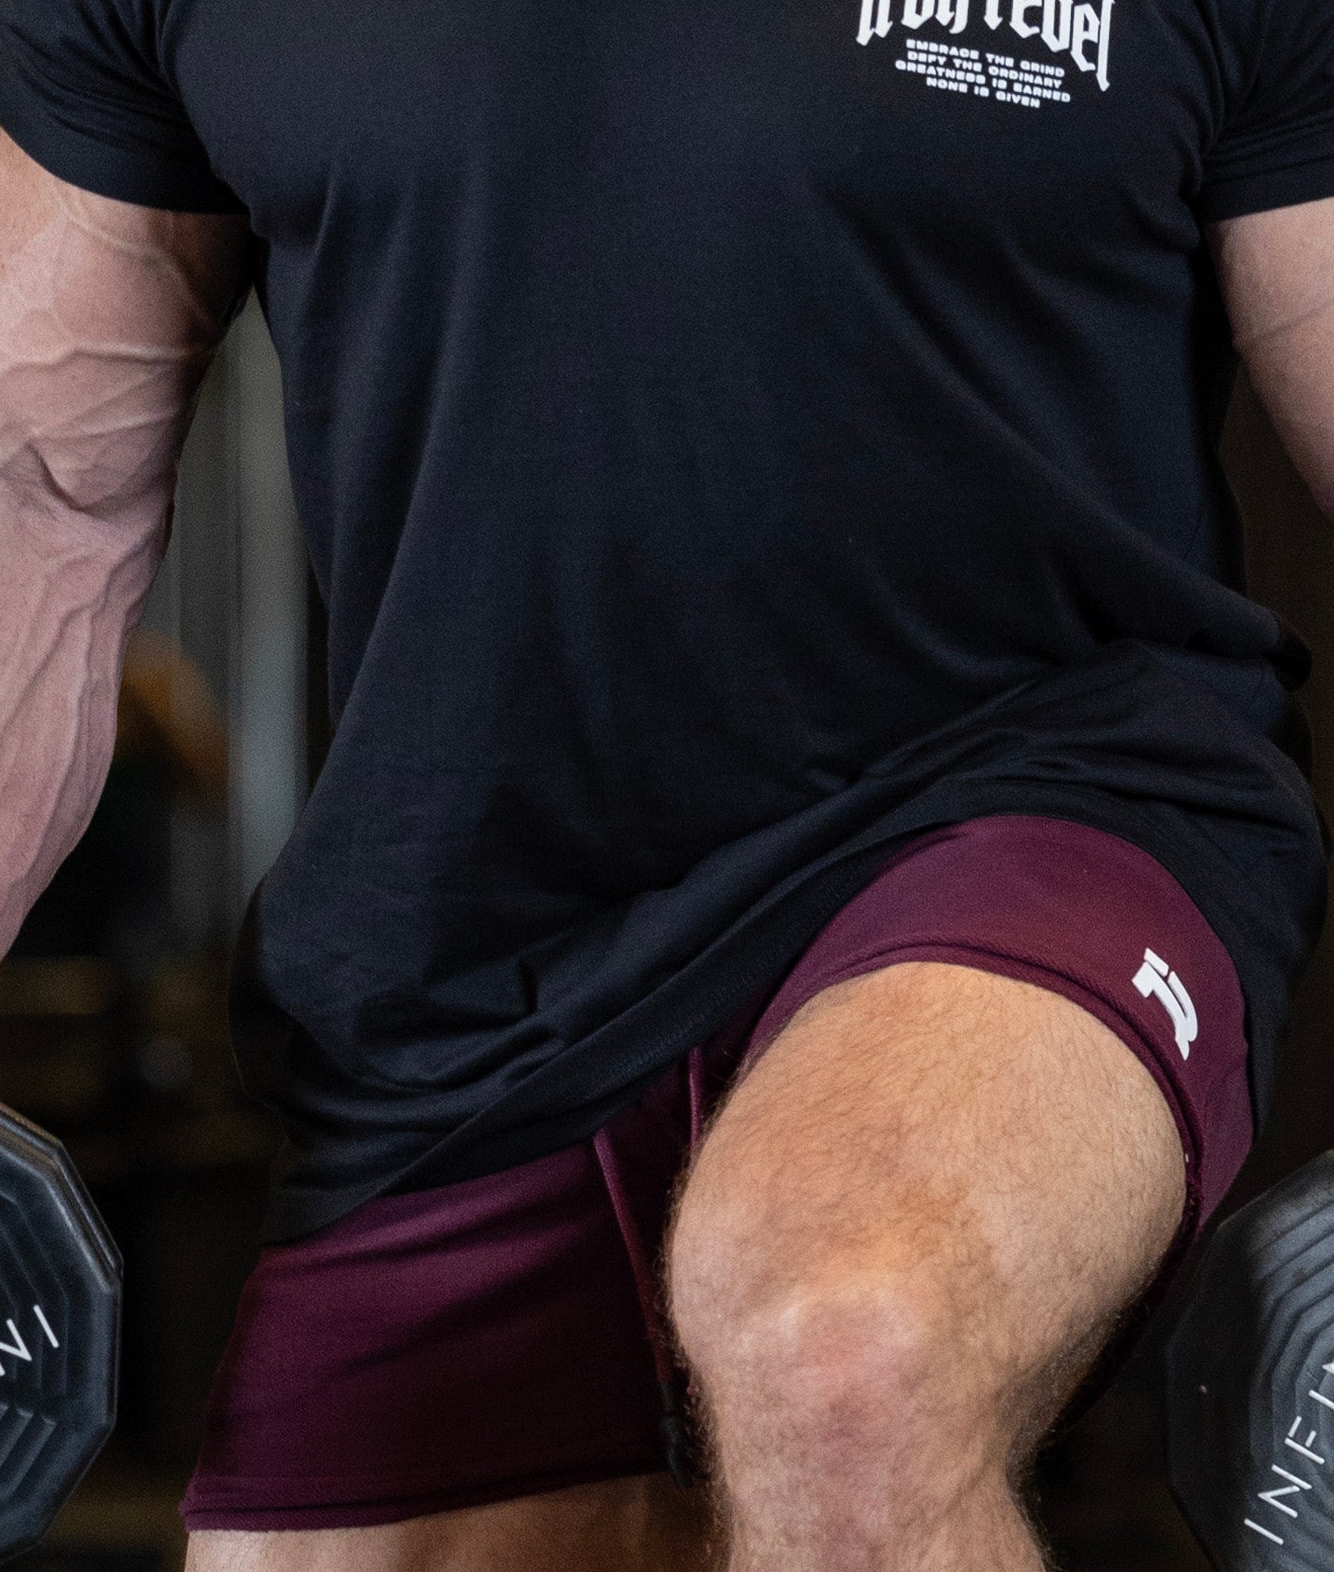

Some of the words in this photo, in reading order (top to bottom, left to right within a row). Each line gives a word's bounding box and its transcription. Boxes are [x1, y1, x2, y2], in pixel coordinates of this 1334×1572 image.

[906, 38, 980, 60] EMBRACE
[985, 53, 1014, 67] THE
[1020, 60, 1065, 78] GRIND
[907, 50, 947, 65] DEFY
[952, 58, 982, 72] THE
[988, 65, 1063, 89] ORDINARY
[895, 59, 986, 85] GREATNESS
[992, 77, 1007, 89] IS
[1013, 81, 1071, 103] EARNED
[926, 76, 968, 93] NONE
[974, 85, 990, 97] IS
[995, 90, 1040, 108] GIVEN
